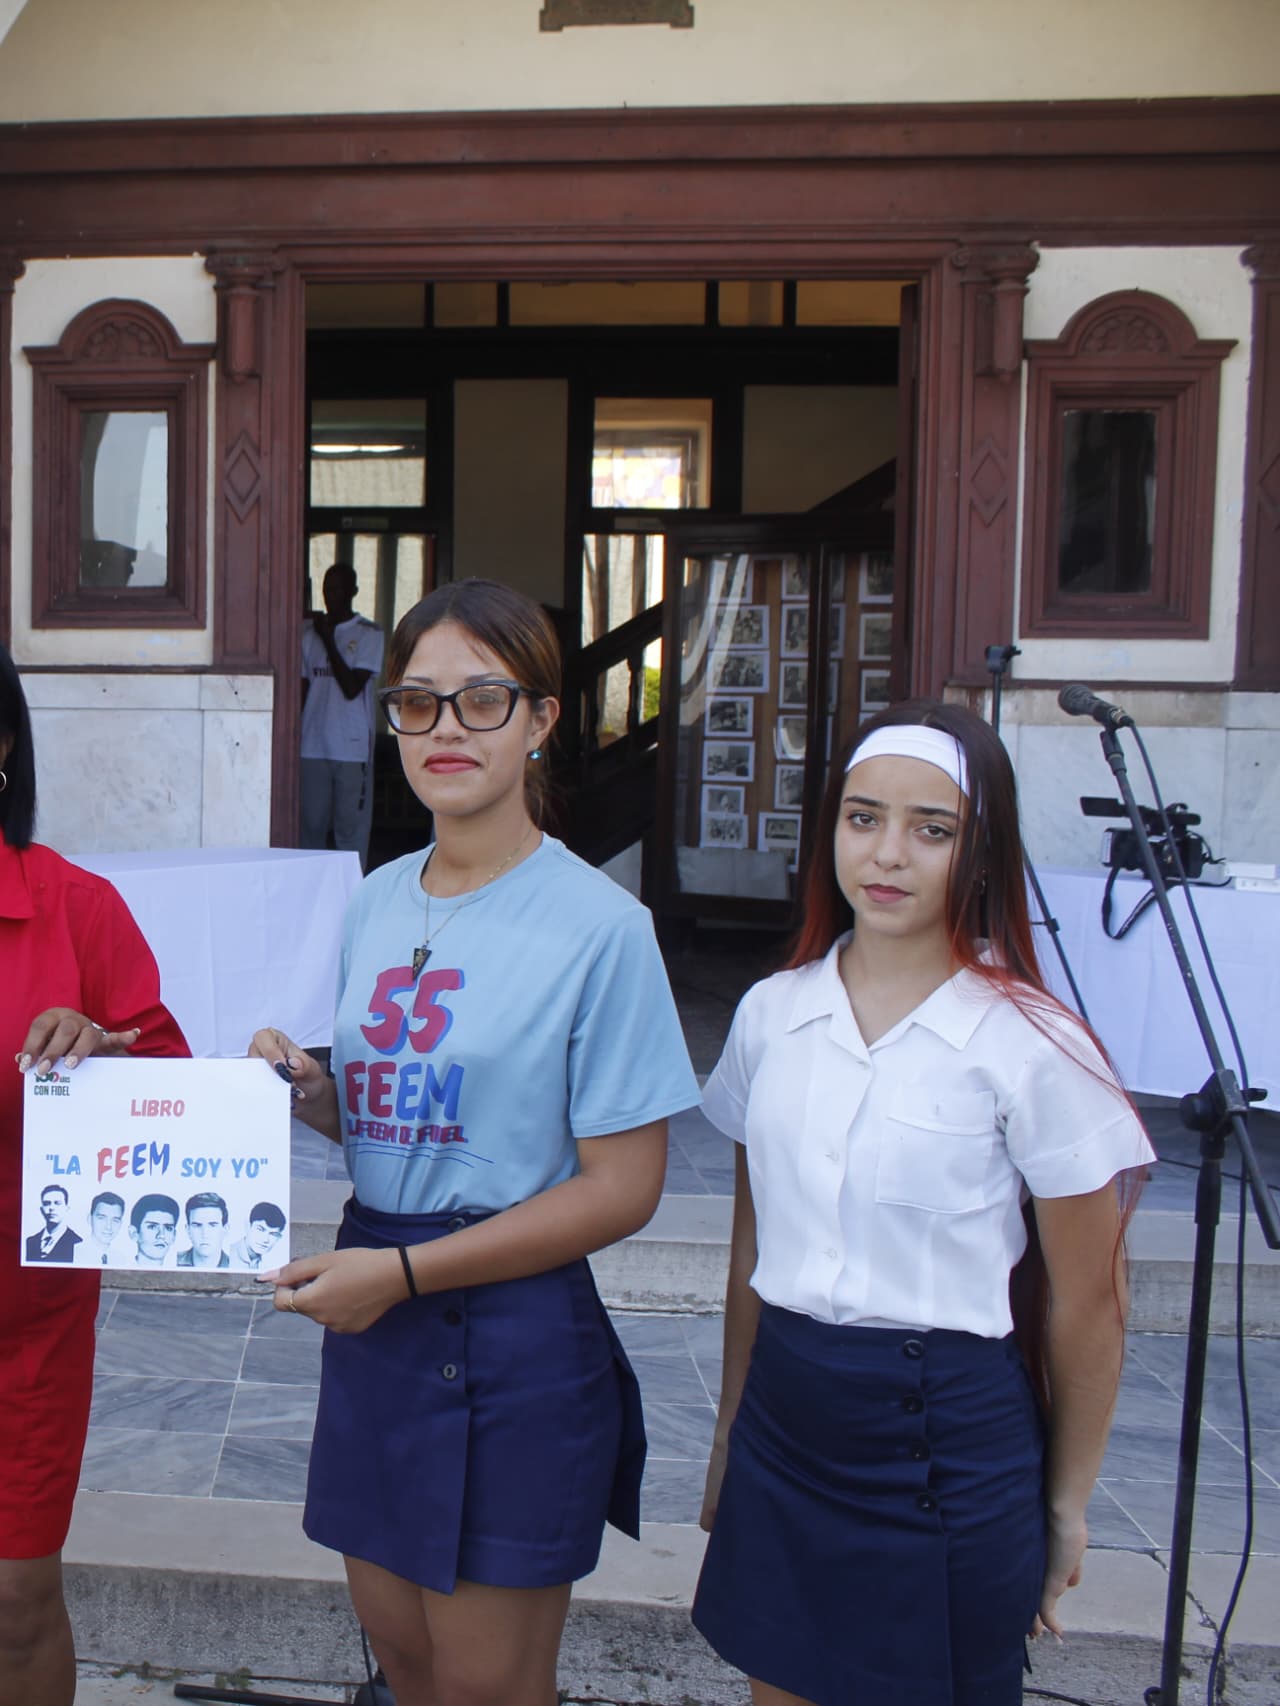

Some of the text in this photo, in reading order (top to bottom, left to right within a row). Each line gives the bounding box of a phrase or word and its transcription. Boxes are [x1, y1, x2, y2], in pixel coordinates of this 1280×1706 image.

[360, 966, 465, 1056] 55
[34, 1085, 70, 1096] CON FIDEL
[130, 1099, 185, 1117] LIBRO
[344, 1061, 465, 1121] FEEM
[46, 1140, 269, 1184] "LA FEEM SOY YO"
